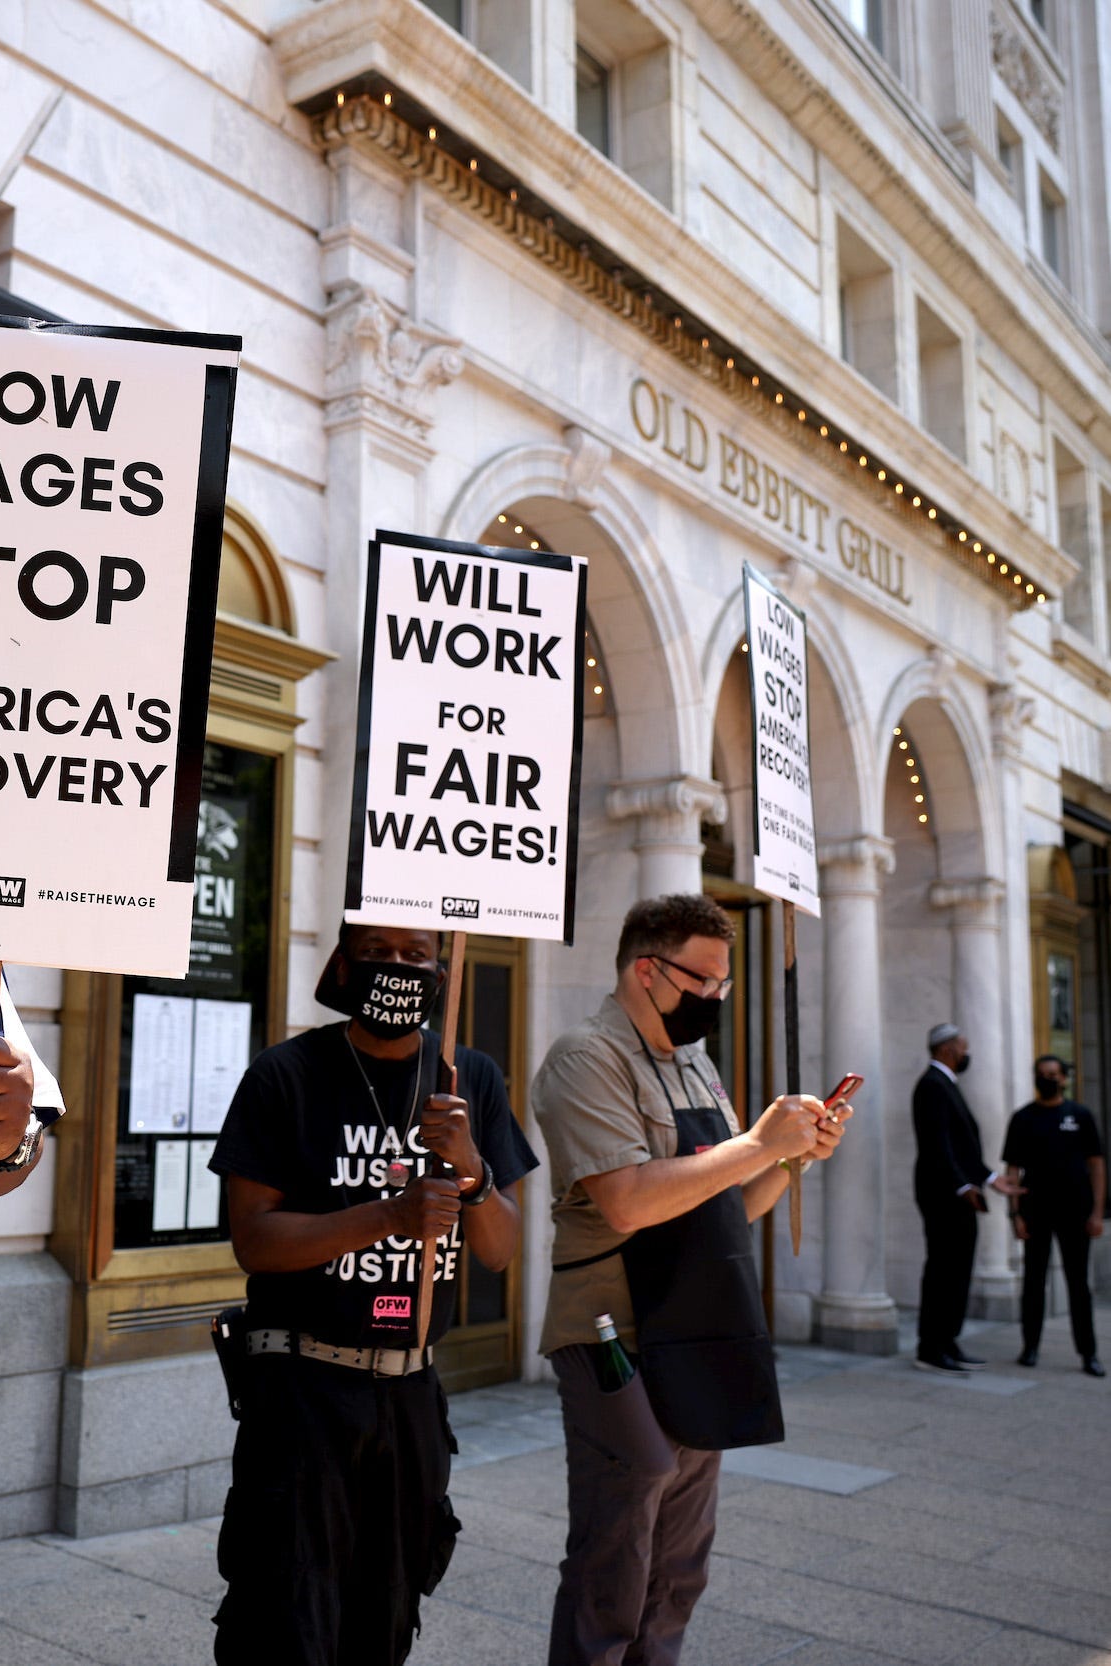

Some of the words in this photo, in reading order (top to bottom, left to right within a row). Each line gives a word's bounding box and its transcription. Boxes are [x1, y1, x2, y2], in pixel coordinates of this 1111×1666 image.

[629, 377, 709, 474] OLD
[718, 431, 830, 553] EBBITT
[836, 517, 912, 607] GRILL
[413, 557, 543, 618] WILL
[766, 596, 794, 640] LOW
[386, 614, 562, 680] WORK
[758, 626, 802, 686] WAGES
[764, 670, 802, 727] STOP
[437, 701, 506, 736] FOR
[395, 742, 541, 811] FAIR
[367, 810, 558, 866] WAGES!
[763, 816, 780, 836] ONE
[37, 889, 157, 909] #RAISETHEWAGE
[361, 895, 434, 909] ONEFAIRWAGE
[443, 898, 478, 912] OFW
[487, 906, 560, 922] #RAISETHEWAGE
[374, 972, 424, 994] FIGHT,
[369, 988, 423, 1008] DON'T
[361, 1002, 422, 1024] STARVE
[375, 1298, 408, 1310] OFW
